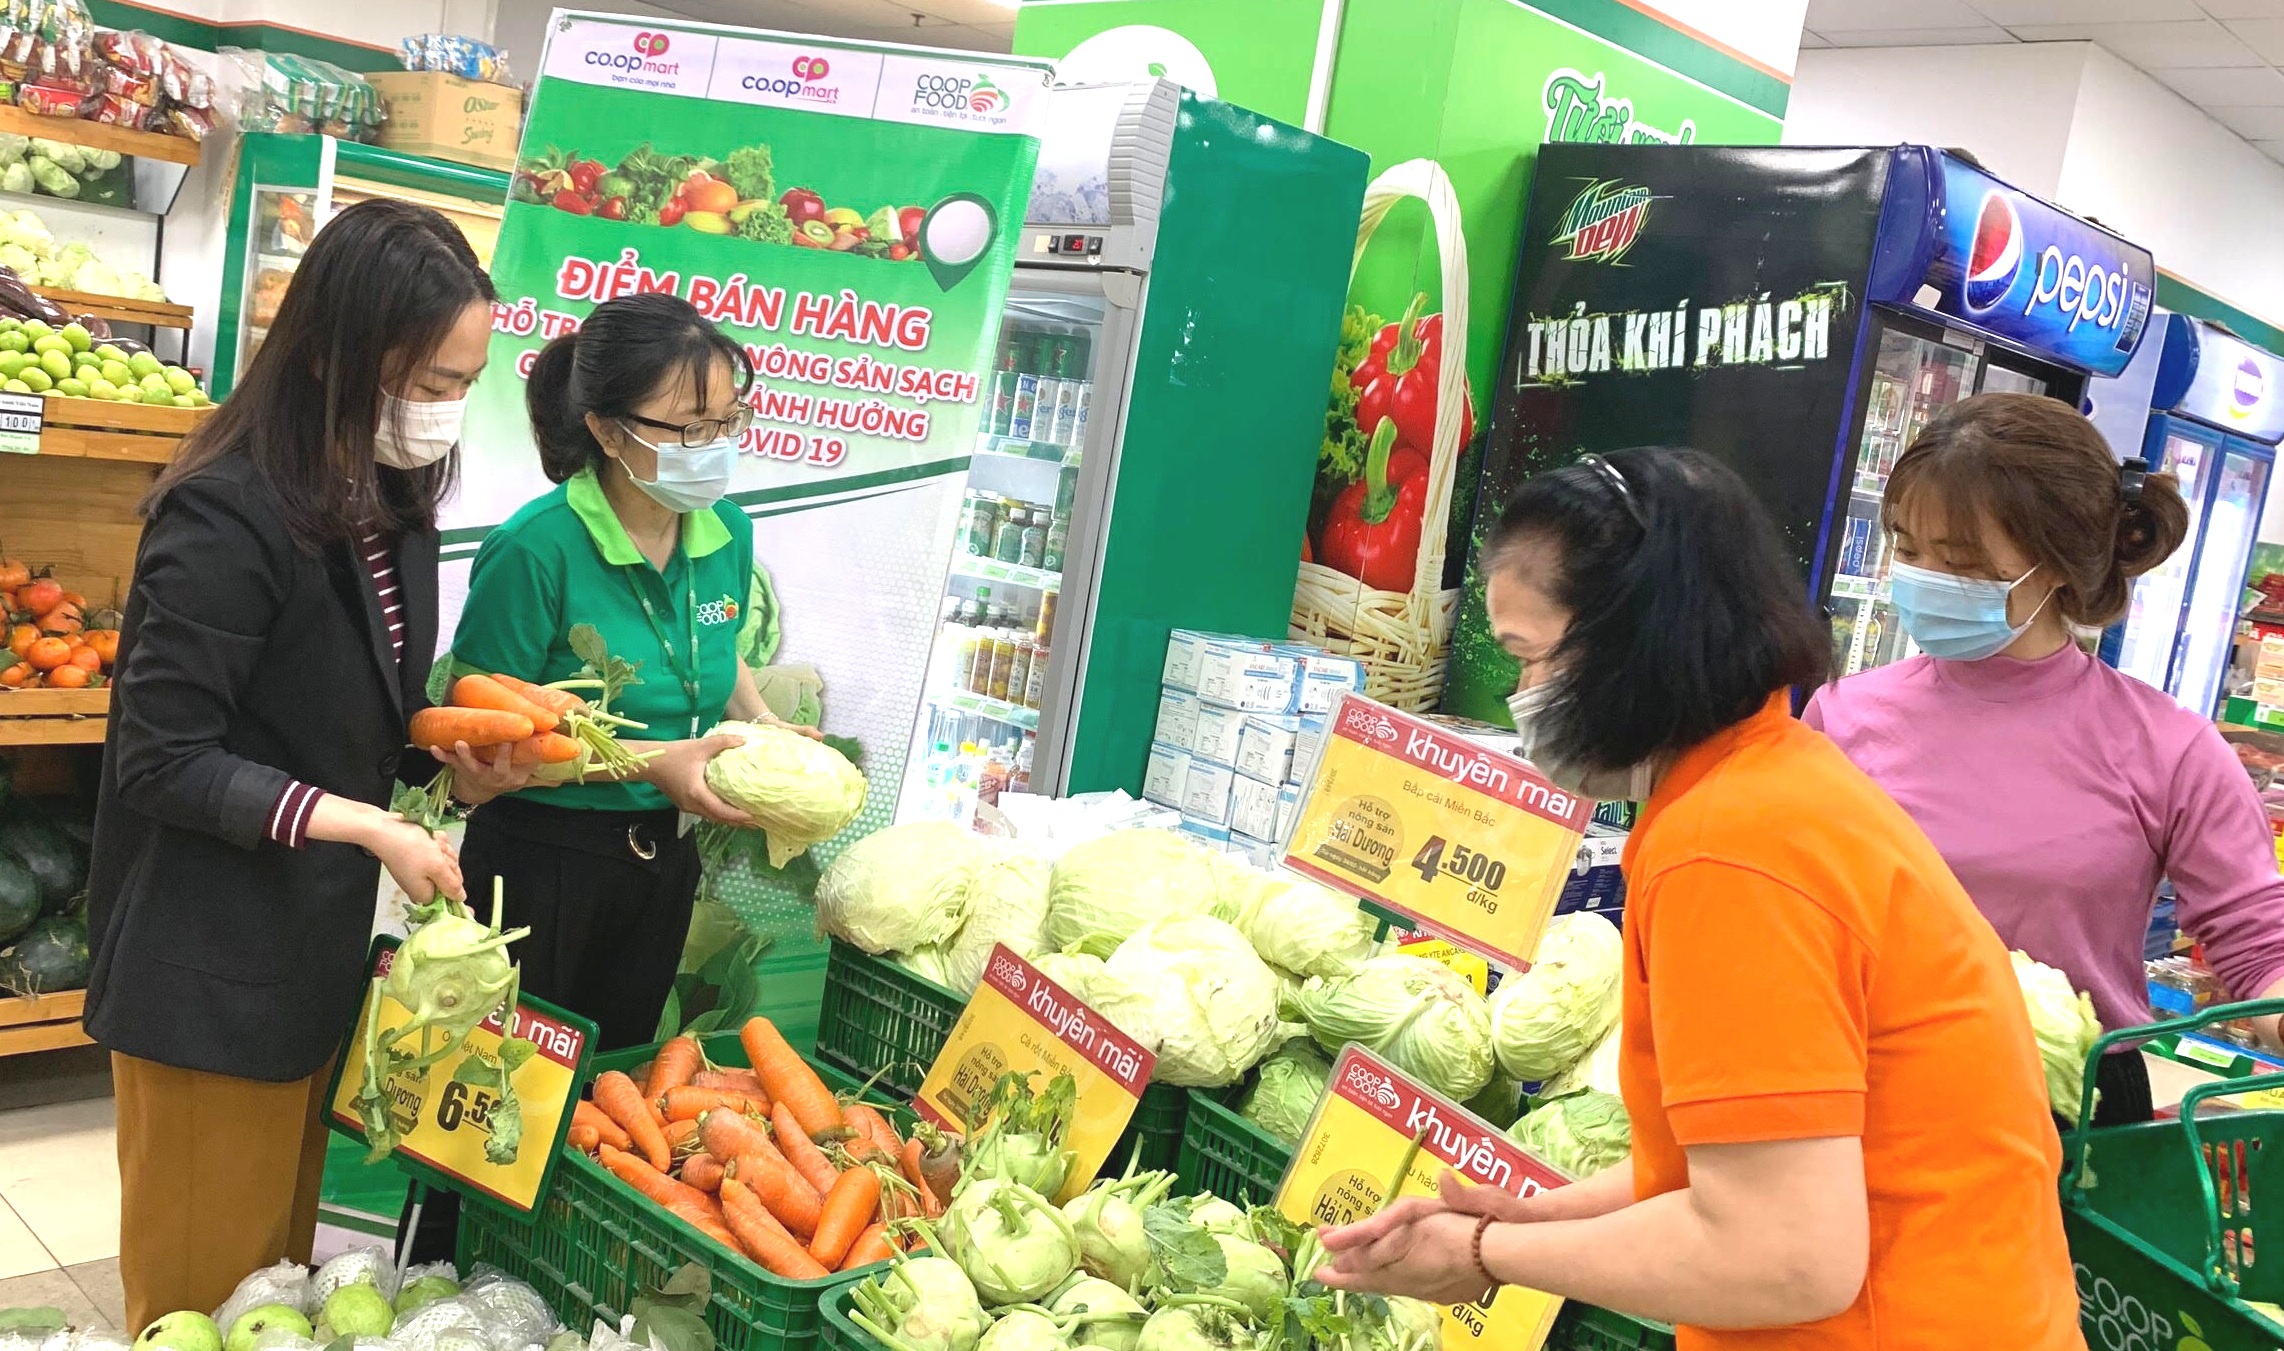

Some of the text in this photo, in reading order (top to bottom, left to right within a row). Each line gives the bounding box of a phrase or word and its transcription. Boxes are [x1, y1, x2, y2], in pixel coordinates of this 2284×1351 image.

[913, 90, 967, 110] FOOD
[1563, 187, 1650, 237] Mountain
[560, 251, 929, 347] ĐIỂM BÁN HÀNG
[2024, 245, 2129, 333] pepsi
[1528, 291, 1832, 376] THỎA KHÍ PHÁCH
[490, 300, 976, 403] HỖ TR NÔNG SẢN SẠCH
[749, 385, 927, 438] ẢNH HƯỞNG
[739, 427, 843, 463] OVID 19
[697, 600, 724, 614] OOP
[1404, 729, 1509, 792] khuyến
[1348, 810, 1375, 829] nông
[1375, 807, 1391, 820] trợ
[1352, 828, 1395, 868] Dương
[1411, 835, 1507, 891] 4.500
[1466, 889, 1498, 914] đ/kg
[528, 1019, 581, 1060] mãi
[1027, 979, 1096, 1050] khuyến
[1097, 1038, 1143, 1084] mãi
[460, 1041, 474, 1053] iệt
[475, 1045, 498, 1064] Nam
[971, 1056, 988, 1077] nông
[954, 1063, 973, 1090] Hải
[1345, 1073, 1377, 1098] FOOD
[1406, 1096, 1512, 1189] khuyến
[1336, 1185, 1363, 1211] nông
[1349, 1174, 1383, 1203] Hỗ trợ
[1315, 1193, 1341, 1226] Hải
[1452, 1304, 1484, 1337] đ/kg
